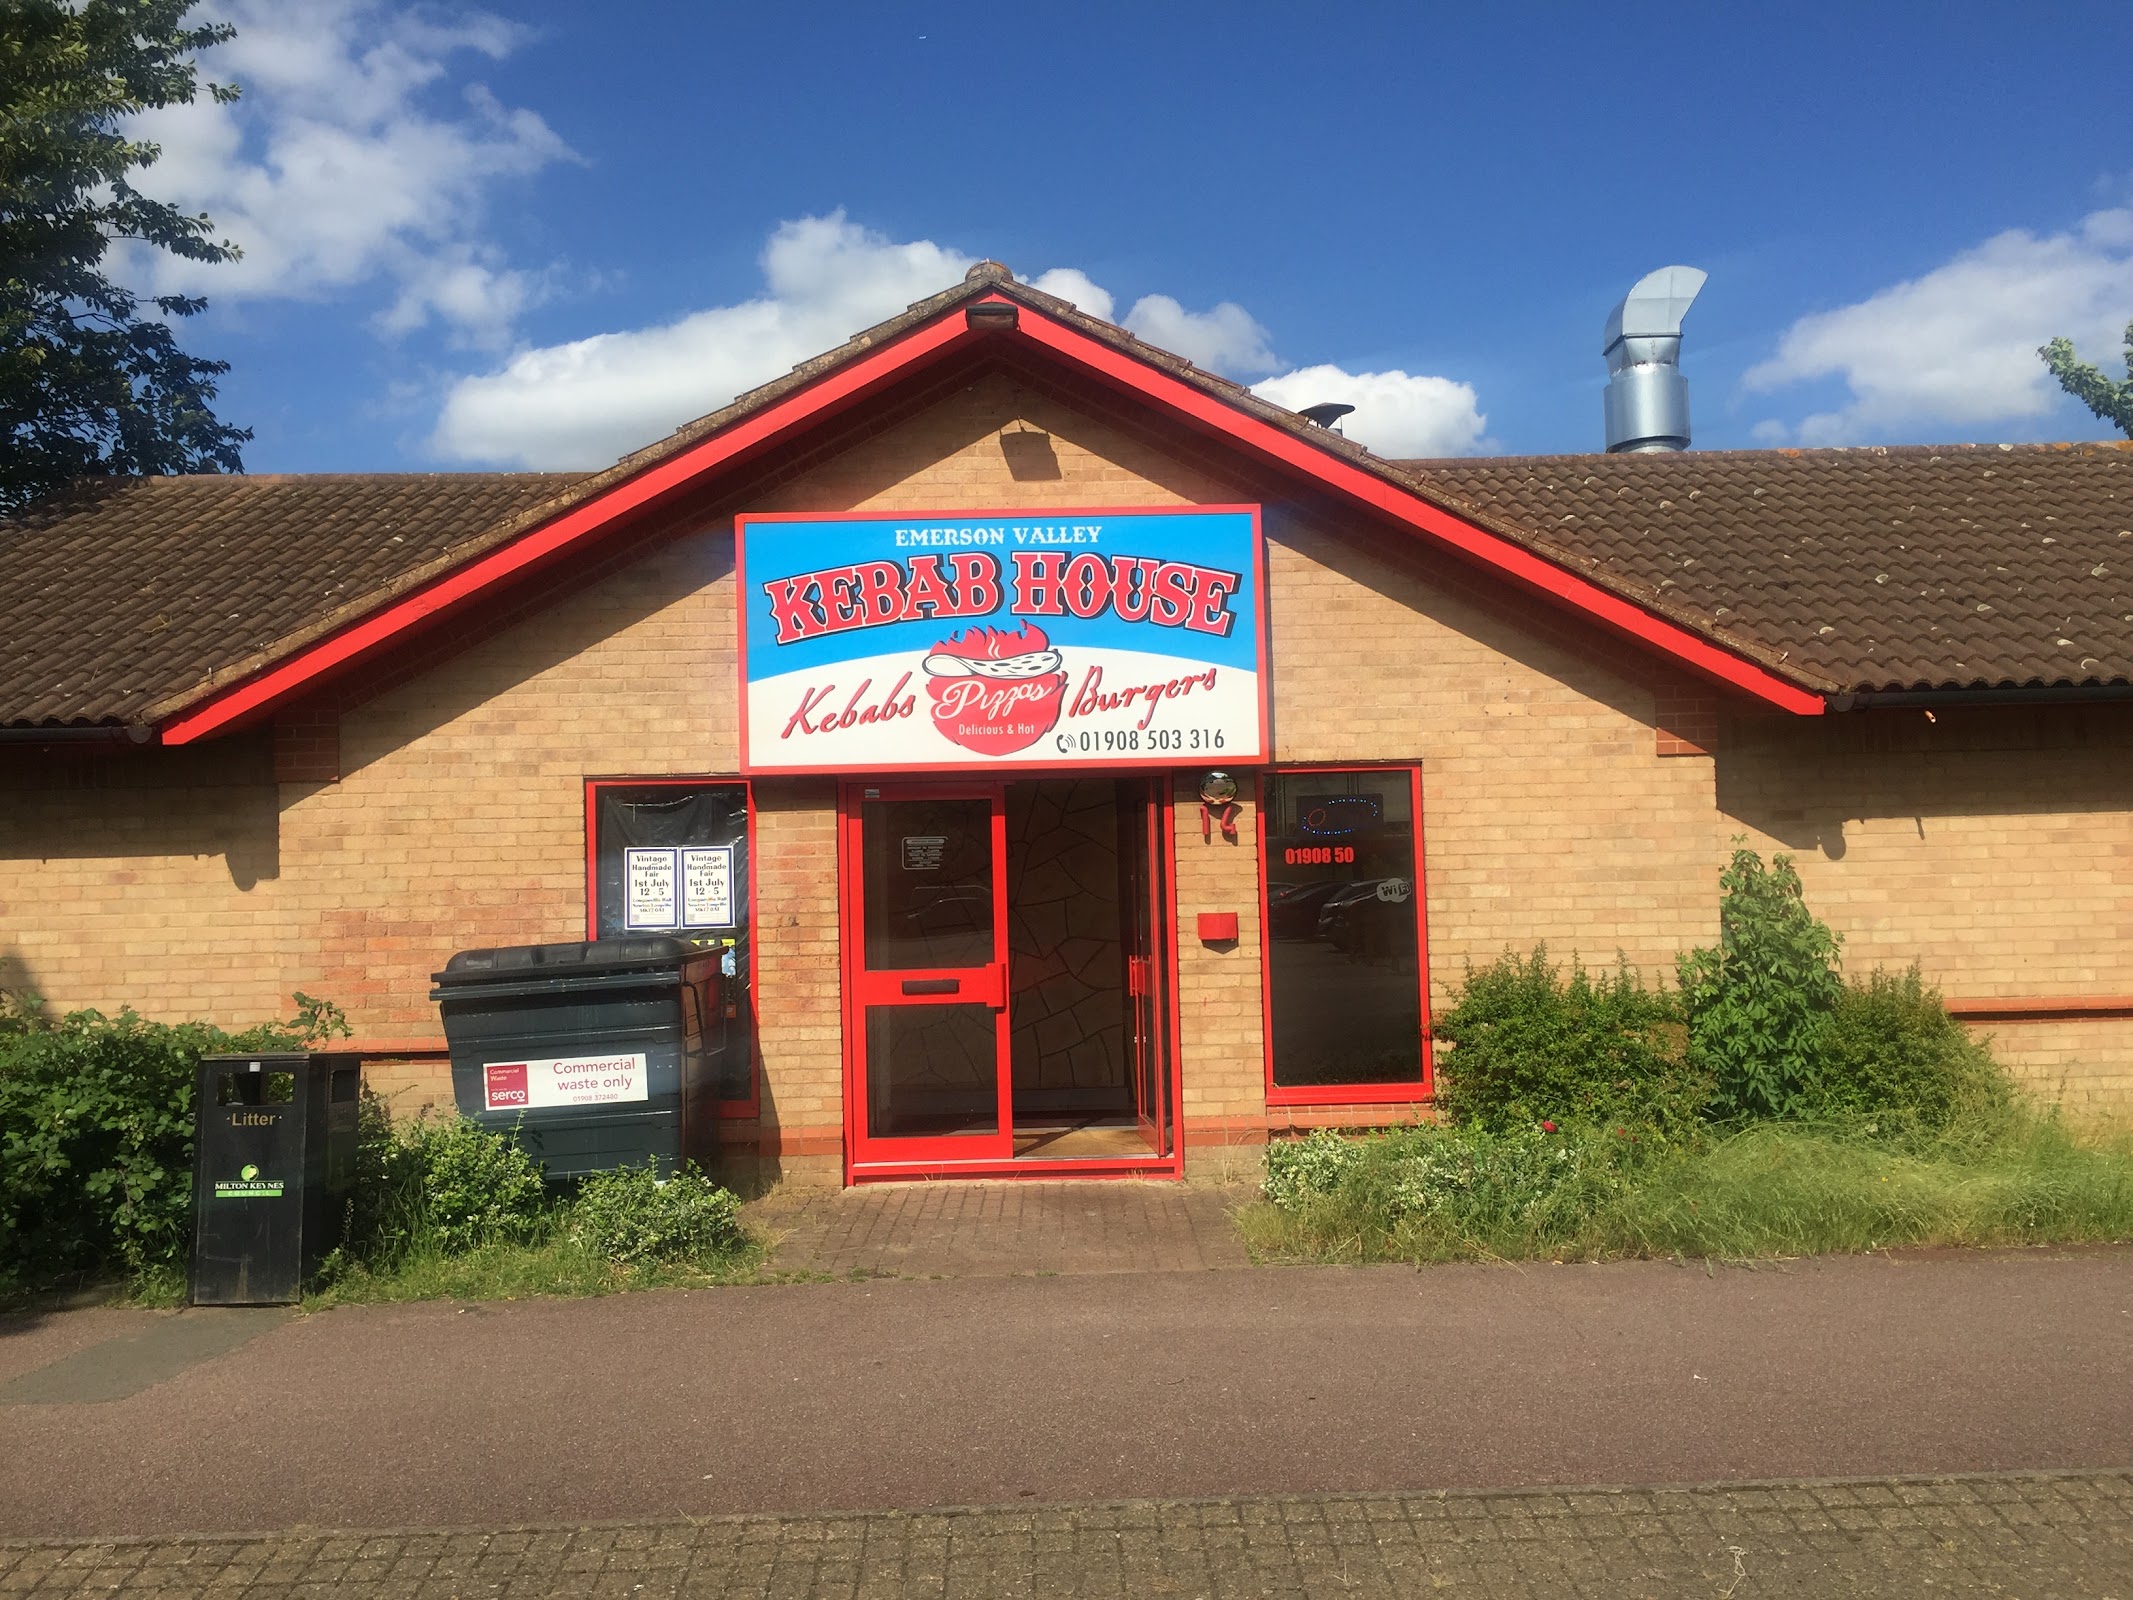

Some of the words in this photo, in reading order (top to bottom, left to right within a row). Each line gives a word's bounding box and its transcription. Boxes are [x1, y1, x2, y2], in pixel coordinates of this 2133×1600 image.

[895, 528, 1005, 547] EMERSON
[1013, 526, 1102, 545] VALLEY
[762, 551, 1005, 646] KEBAB
[1010, 551, 1242, 638] HOUSE
[934, 680, 1053, 720] Pizzas
[1068, 665, 1217, 730] Burgers
[781, 671, 916, 739] Kebabs
[958, 723, 1004, 736] Delicious
[1007, 724, 1015, 735] &
[1017, 723, 1035, 735] Hot
[1080, 731, 1139, 751] 01908
[1148, 730, 1183, 750] 503
[1190, 729, 1225, 749] 316
[691, 854, 722, 862] Vintage
[1285, 847, 1332, 864] 01908
[1334, 846, 1355, 863] 50
[634, 879, 648, 887] 1st
[651, 879, 669, 888] July
[689, 879, 703, 887] 1st
[705, 878, 725, 887] July
[640, 888, 650, 896] 12
[658, 887, 664, 896] 5
[695, 887, 705, 895] 12
[713, 887, 719, 895] 5
[553, 1057, 635, 1074] Commercial
[490, 1074, 507, 1082] Waste
[557, 1078, 598, 1090] waste
[603, 1074, 632, 1089] only
[491, 1090, 525, 1102] serco
[573, 1094, 592, 1102] 01908
[232, 1112, 276, 1126] Litter
[215, 1182, 248, 1190] MILTON
